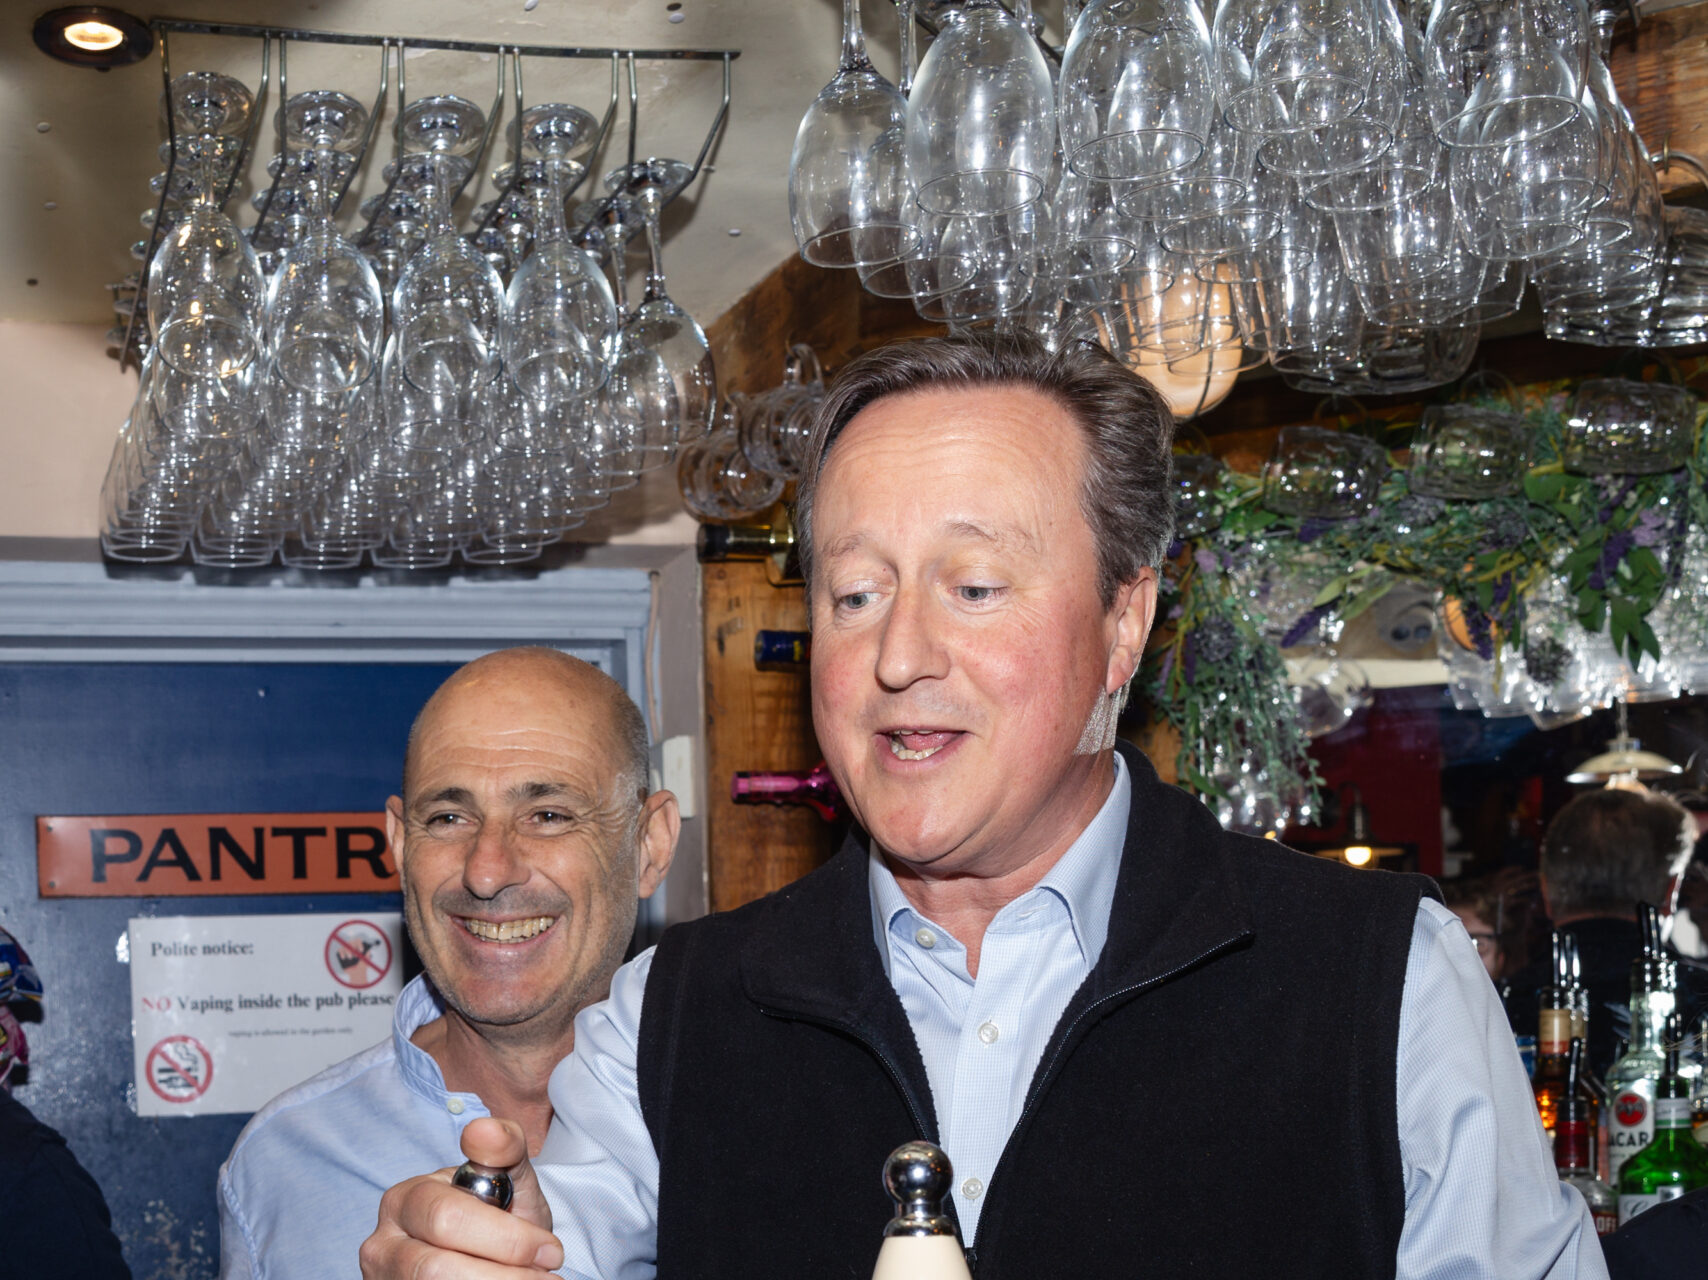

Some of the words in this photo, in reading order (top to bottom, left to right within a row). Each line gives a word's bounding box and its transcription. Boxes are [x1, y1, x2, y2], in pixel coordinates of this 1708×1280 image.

[151, 942, 198, 957] Polite
[202, 941, 254, 956] notice:
[141, 996, 171, 1013] NO
[177, 995, 233, 1015] Vaping
[238, 993, 282, 1009] inside
[288, 993, 311, 1008] the
[315, 992, 343, 1011] pub
[348, 991, 394, 1010] please
